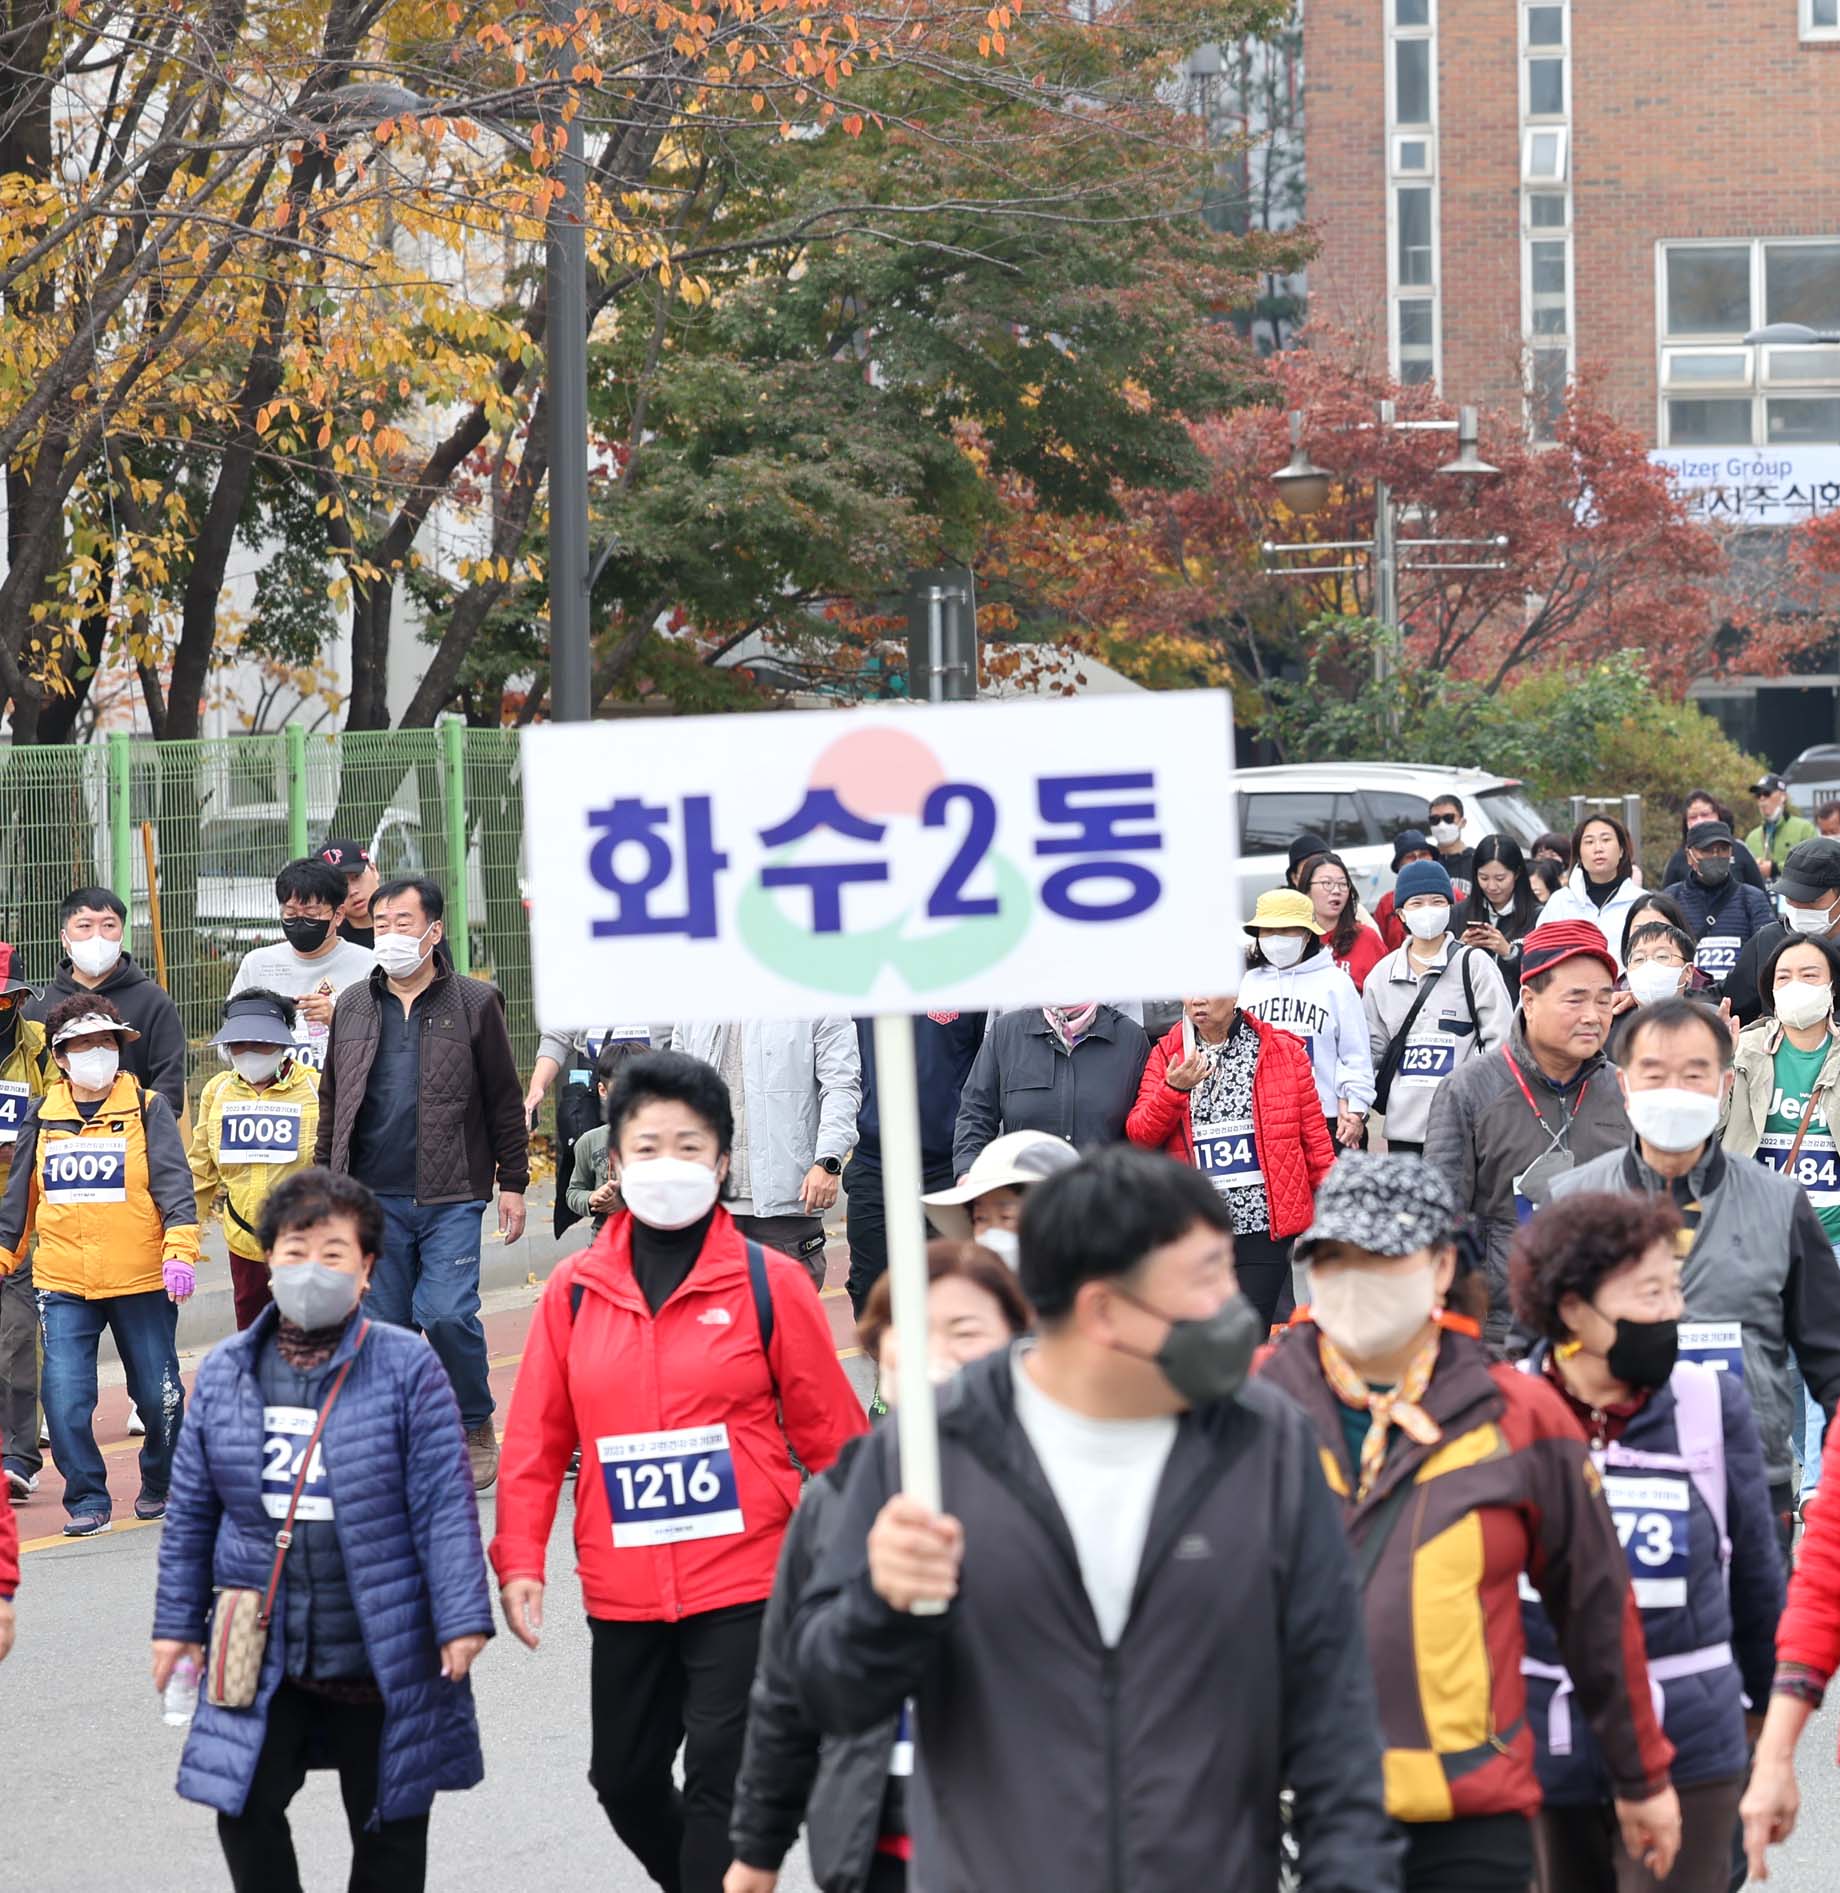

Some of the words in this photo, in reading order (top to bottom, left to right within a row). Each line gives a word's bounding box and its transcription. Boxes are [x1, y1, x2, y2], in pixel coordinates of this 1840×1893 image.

[1727, 459, 1792, 479] Group
[586, 770, 1163, 939] 화수2동
[1403, 1048, 1447, 1070] 1237
[1767, 1088, 1827, 1127] Jee
[228, 1118, 292, 1143] 1008
[50, 1155, 118, 1182] 1009
[261, 1437, 327, 1484] 24
[616, 1459, 720, 1510] 1216
